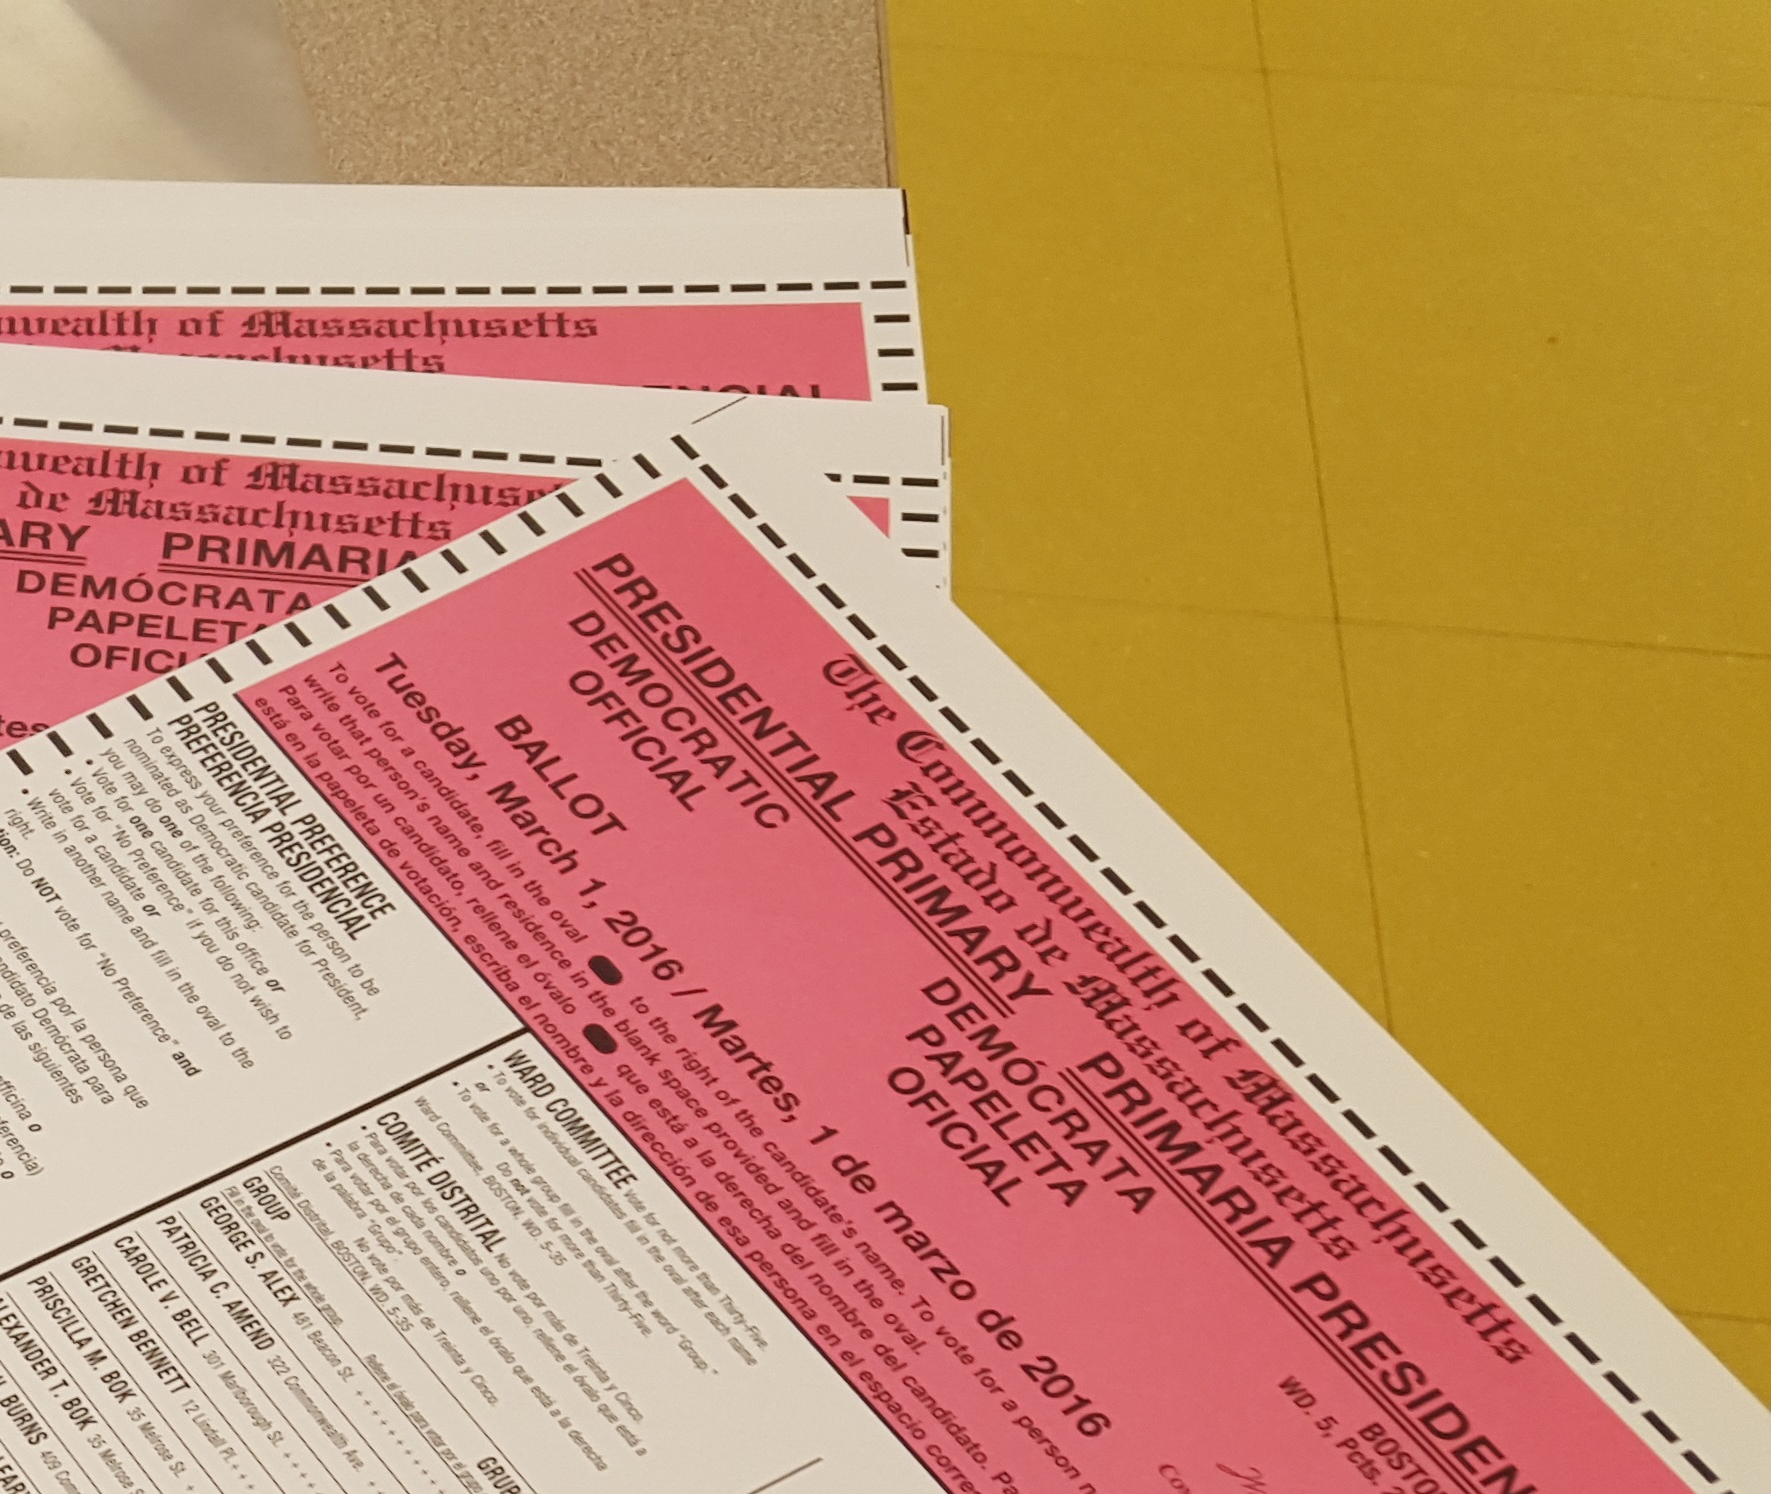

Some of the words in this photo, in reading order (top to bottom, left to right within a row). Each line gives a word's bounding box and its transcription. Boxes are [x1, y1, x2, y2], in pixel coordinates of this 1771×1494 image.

[178, 309, 224, 338] of
[240, 309, 598, 345] Massachusetts
[15, 480, 70, 513] de
[85, 486, 452, 542] Massachusetts
[180, 457, 231, 487] of
[495, 714, 628, 835] BALLOT
[568, 610, 790, 829] DEMOCRATIC
[569, 669, 707, 813] OFFICIAL
[588, 552, 856, 823] PRESIDENTIAL
[853, 822, 1051, 999] PRIMARY
[822, 653, 897, 726] The
[896, 729, 1181, 1011] Commonwealth
[1175, 1018, 1242, 1061] of
[1222, 1068, 1532, 1365] Massachusetts
[883, 781, 1018, 914] Estado
[1014, 917, 1069, 966] de
[1061, 974, 1358, 1261] Massachusetts
[888, 1066, 1023, 1208] OFICIAL
[906, 1025, 1089, 1208] PAPELETA
[921, 976, 1157, 1215] DEMÓCRATA
[1076, 1051, 1295, 1269] PRIMARIA
[376, 1112, 434, 1173] COMITÉ
[426, 1170, 507, 1253] DISTRITAL
